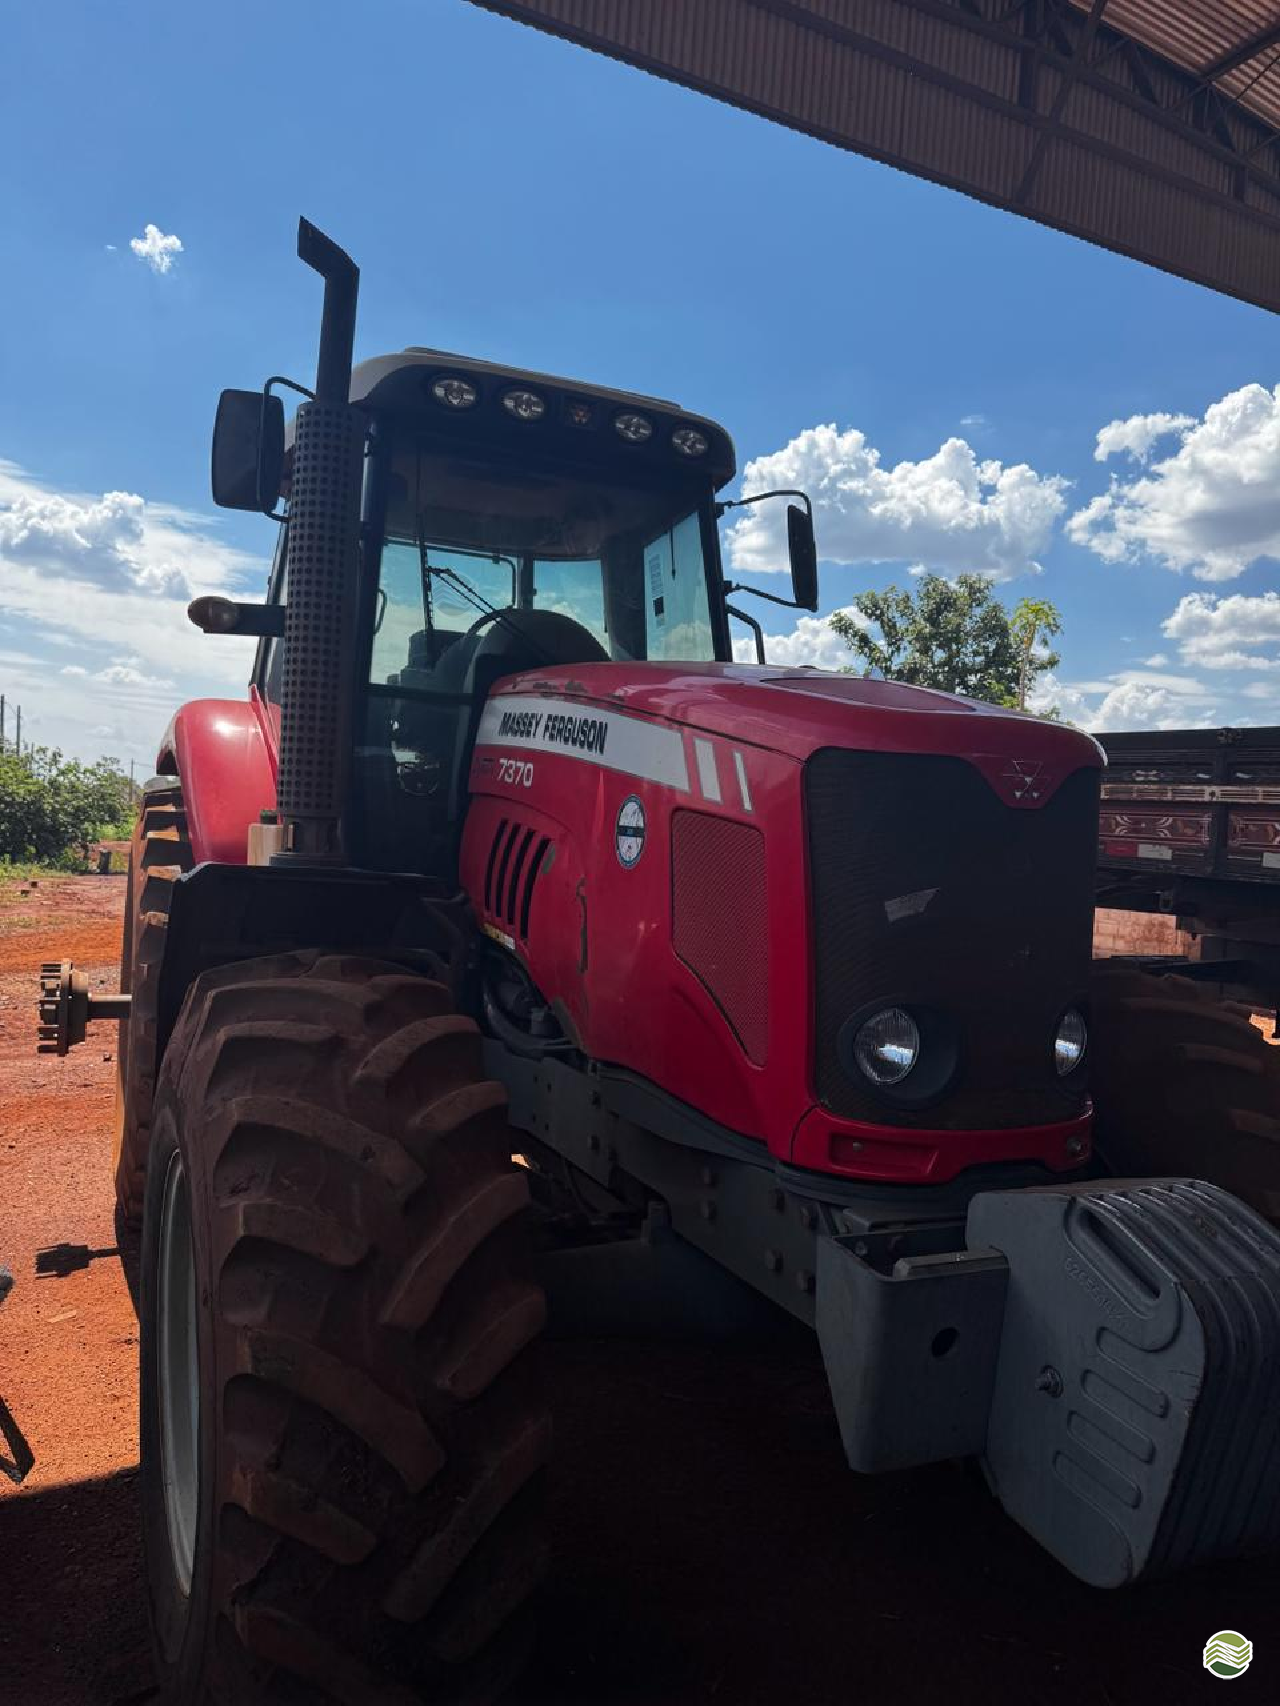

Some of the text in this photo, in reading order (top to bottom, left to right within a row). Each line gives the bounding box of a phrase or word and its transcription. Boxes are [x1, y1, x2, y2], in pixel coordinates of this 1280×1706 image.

[499, 712, 608, 755] MASSEY FERGUSON
[497, 757, 534, 788] 7370
